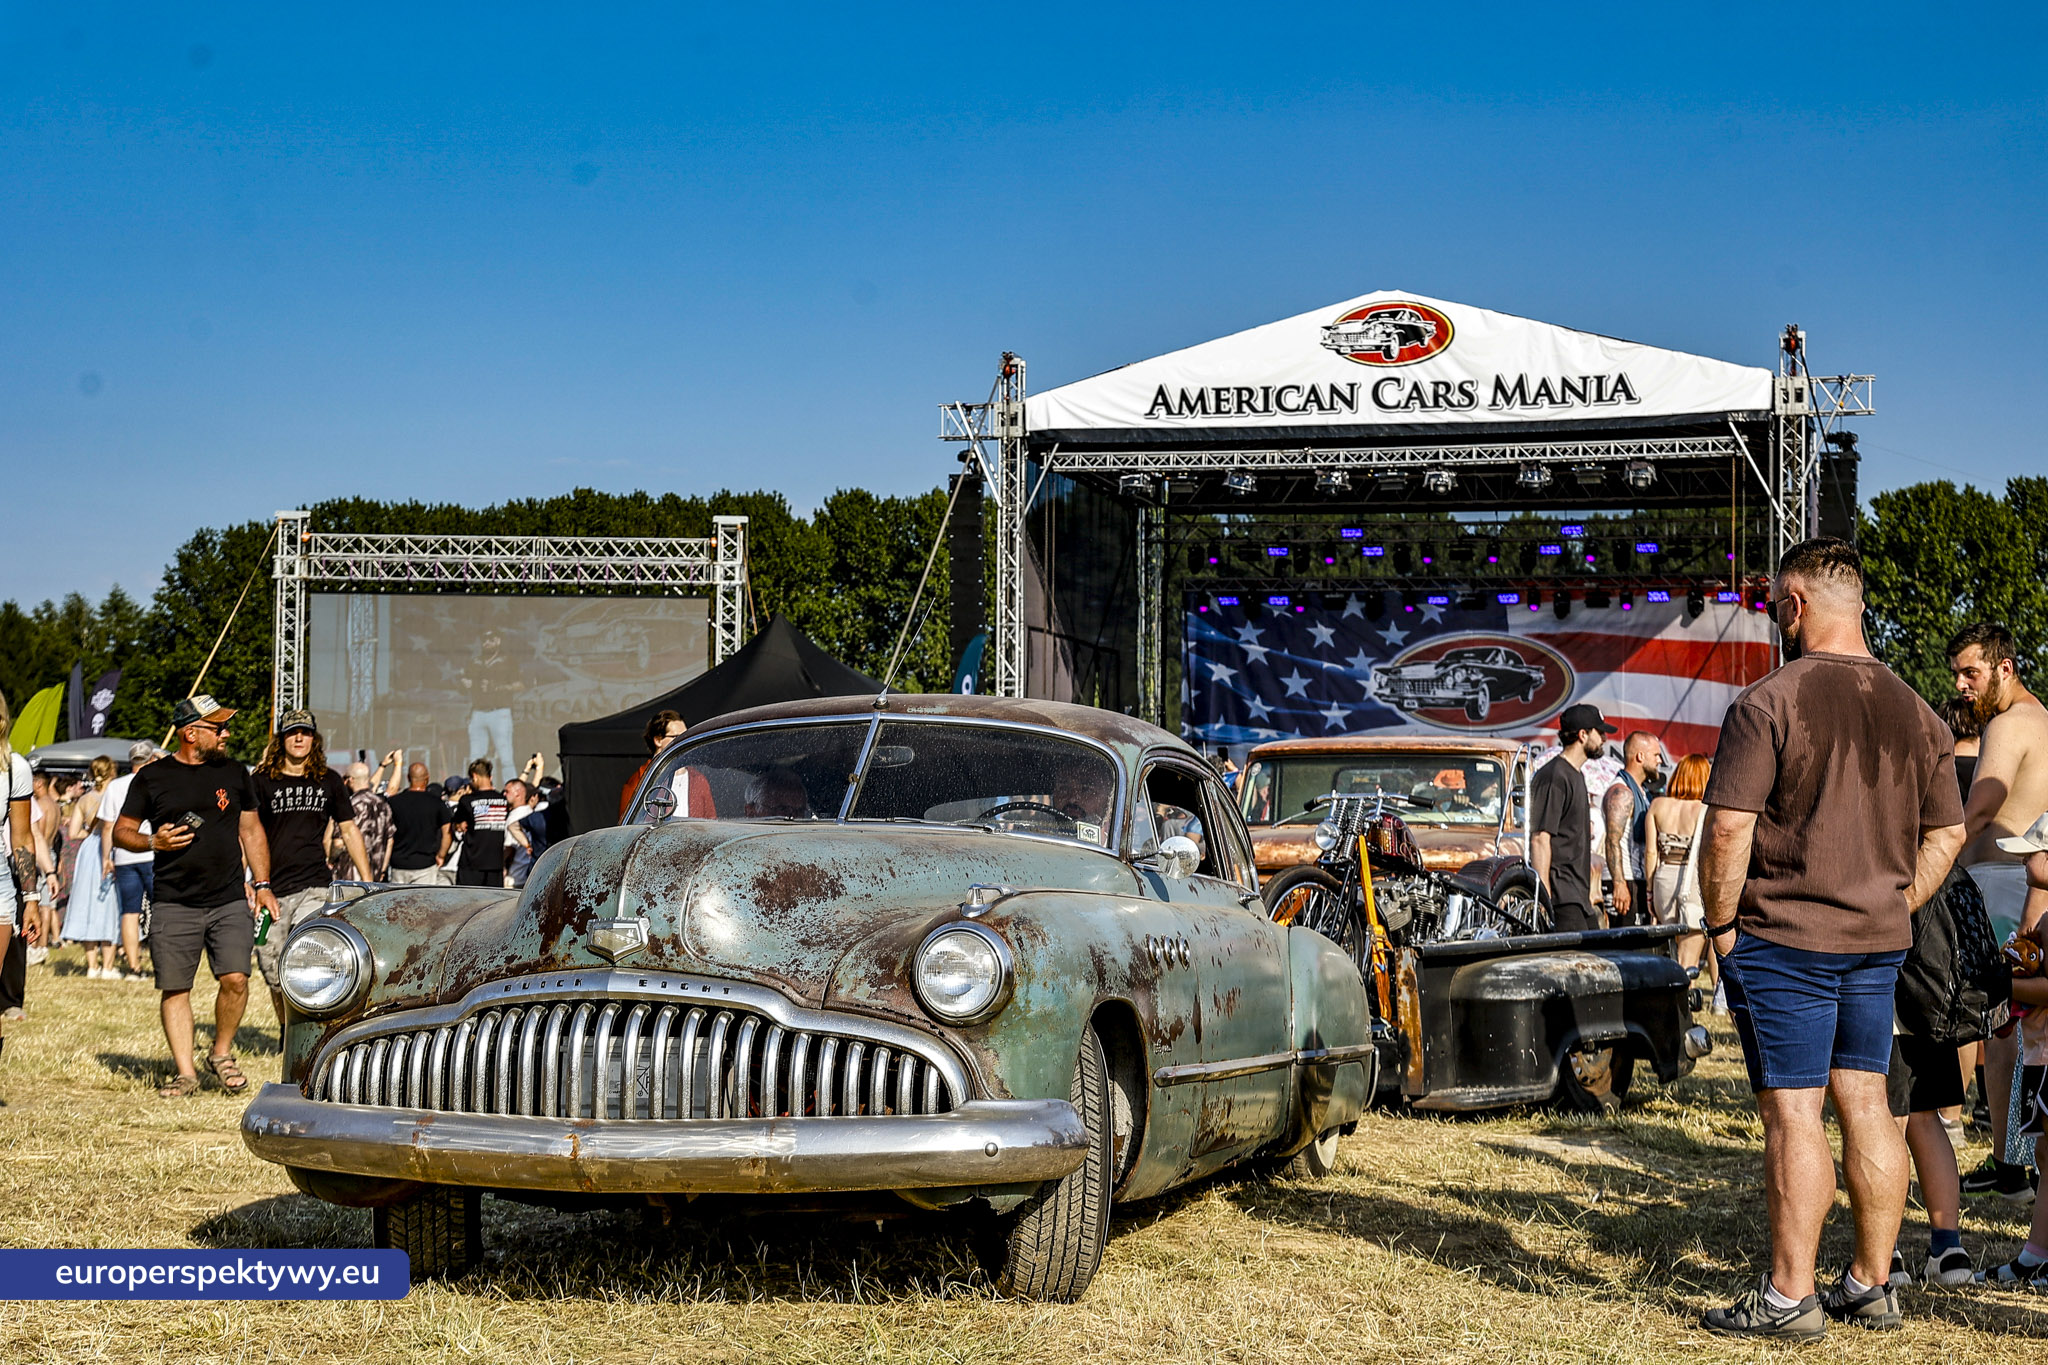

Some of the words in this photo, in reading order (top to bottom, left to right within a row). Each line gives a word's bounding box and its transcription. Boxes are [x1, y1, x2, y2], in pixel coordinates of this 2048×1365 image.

[1144, 383, 1359, 418] AMERICAN
[1371, 375, 1478, 412] CARS
[1487, 372, 1640, 411] MANIA
[285, 786, 313, 797] PRO
[271, 797, 328, 809] CIRCUIT
[503, 978, 583, 993] BUICK
[638, 979, 732, 996] EIGHT
